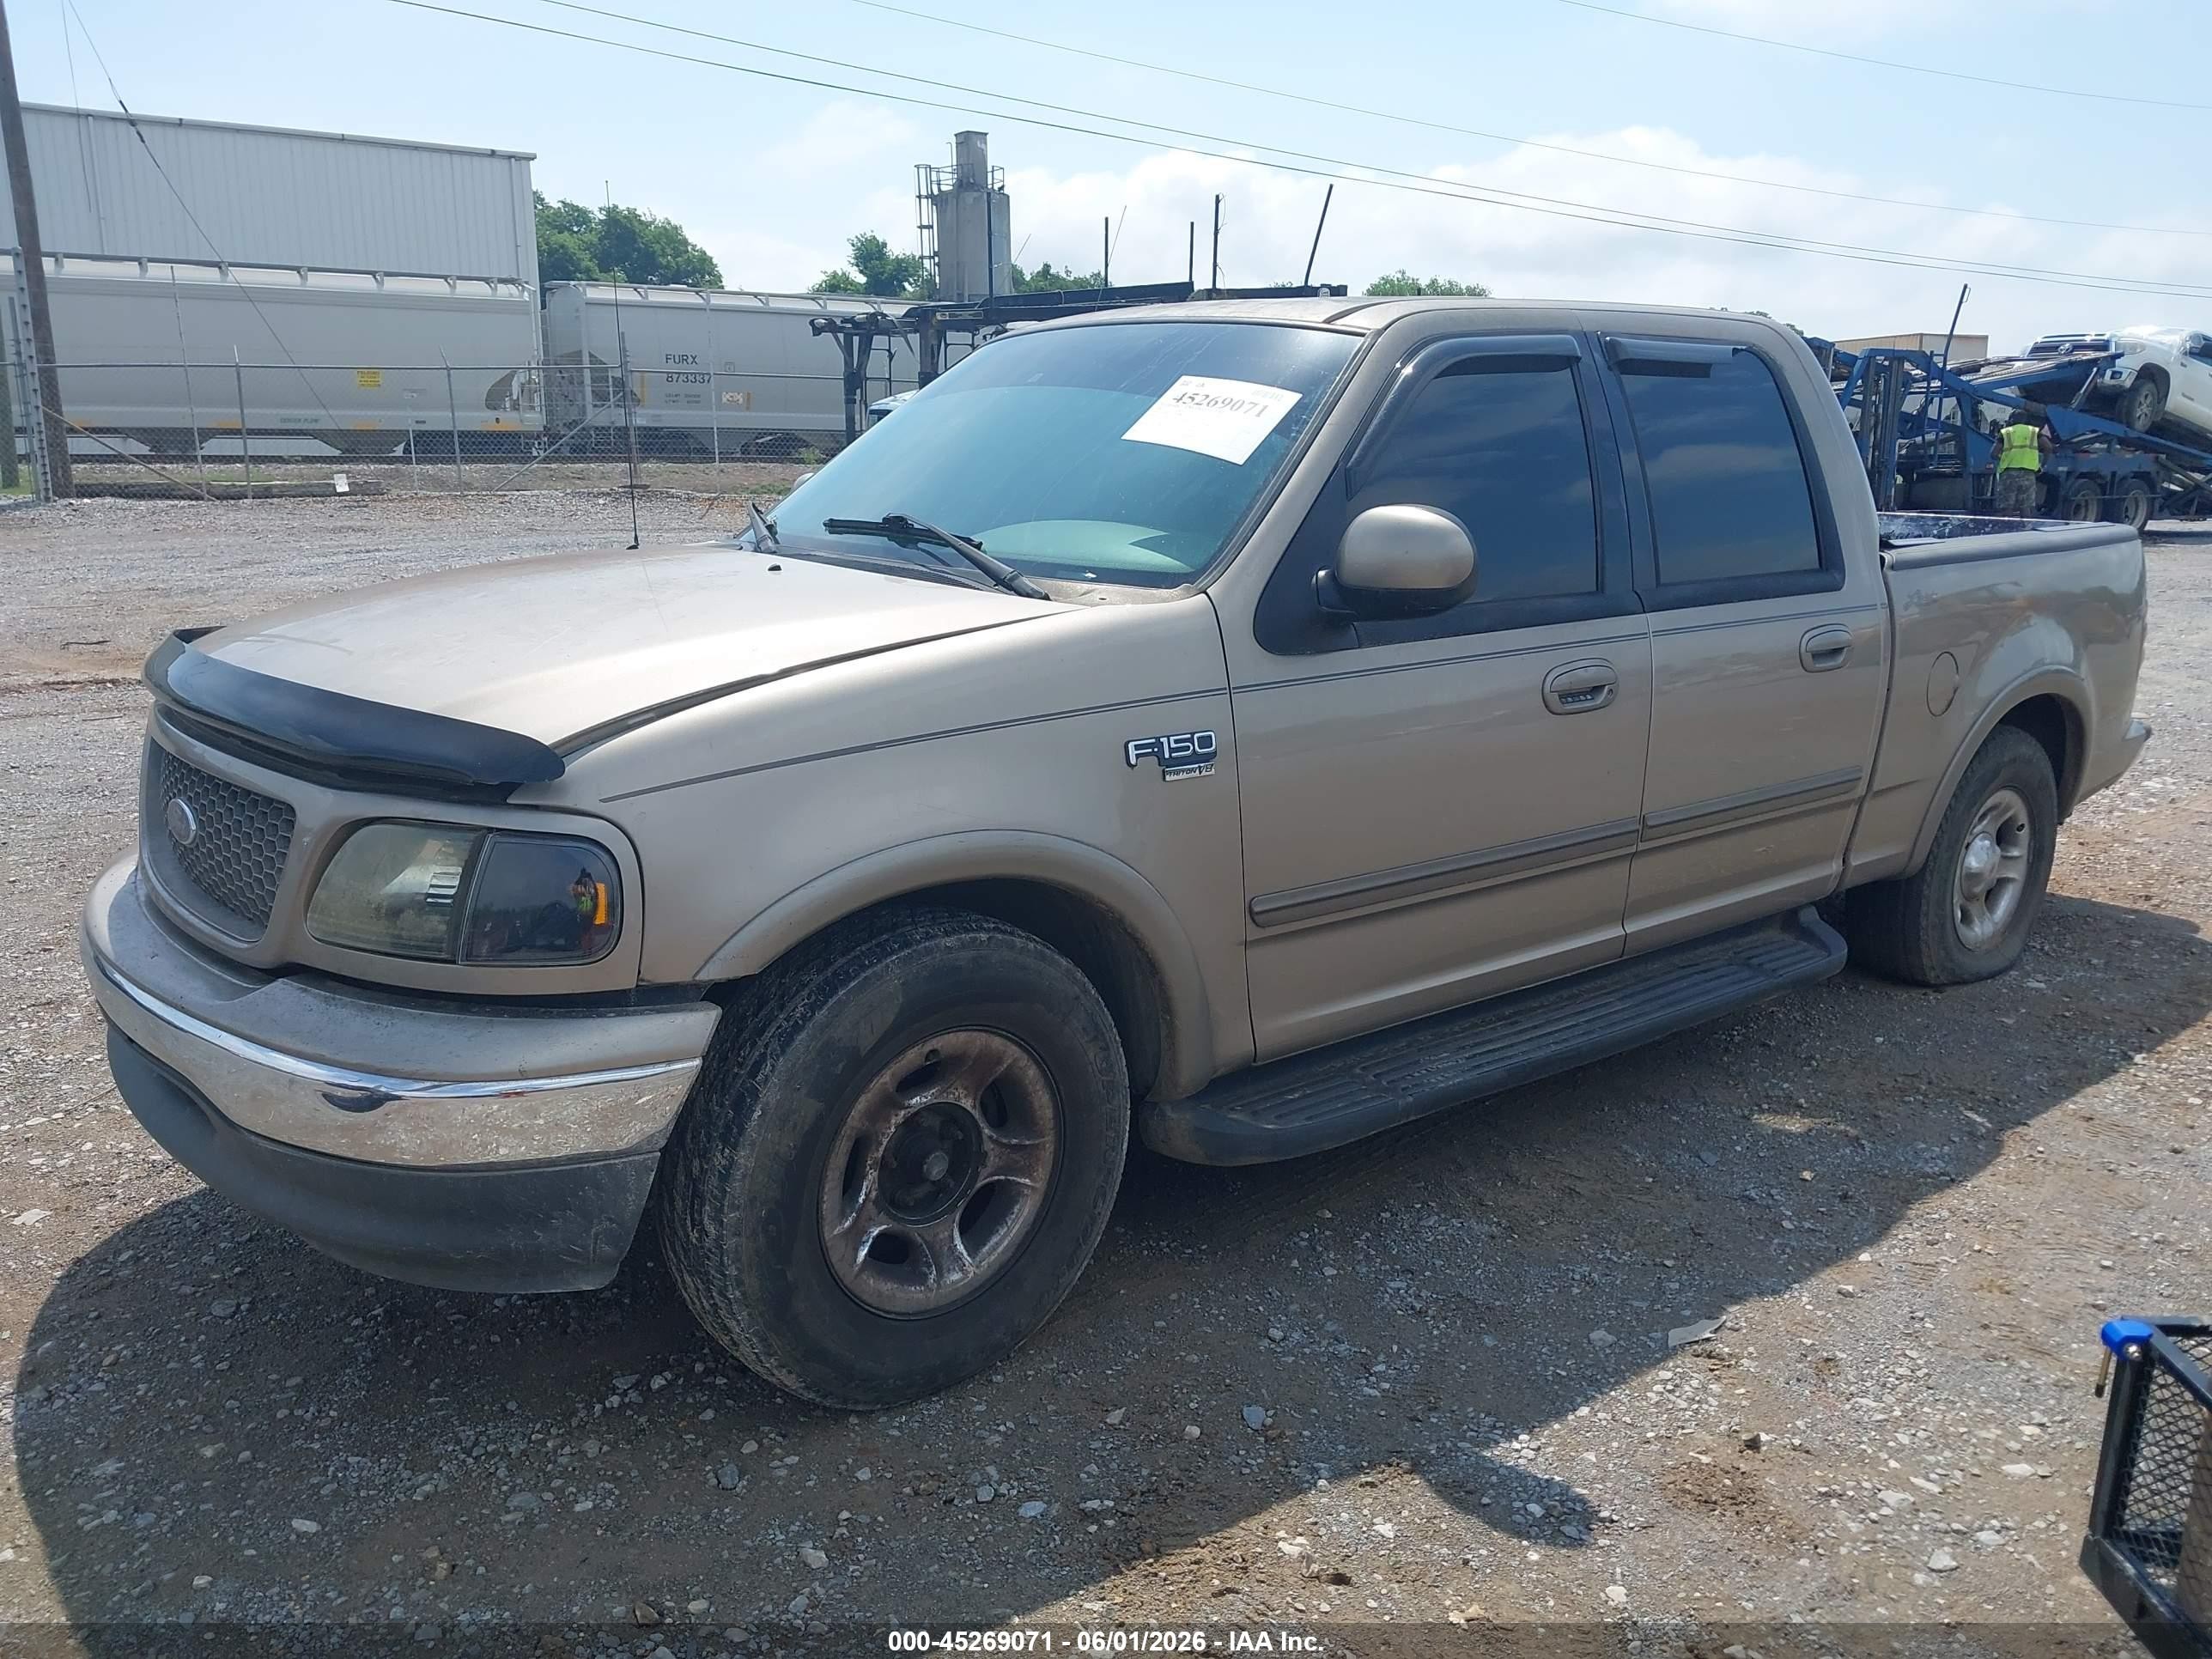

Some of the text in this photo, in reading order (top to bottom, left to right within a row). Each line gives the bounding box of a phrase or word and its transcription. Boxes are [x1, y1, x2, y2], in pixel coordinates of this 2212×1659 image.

[665, 354, 698, 365] FURX
[665, 373, 712, 384] 873337
[1172, 392, 1269, 417] 45269071
[1167, 763, 1214, 777] TRITON V8
